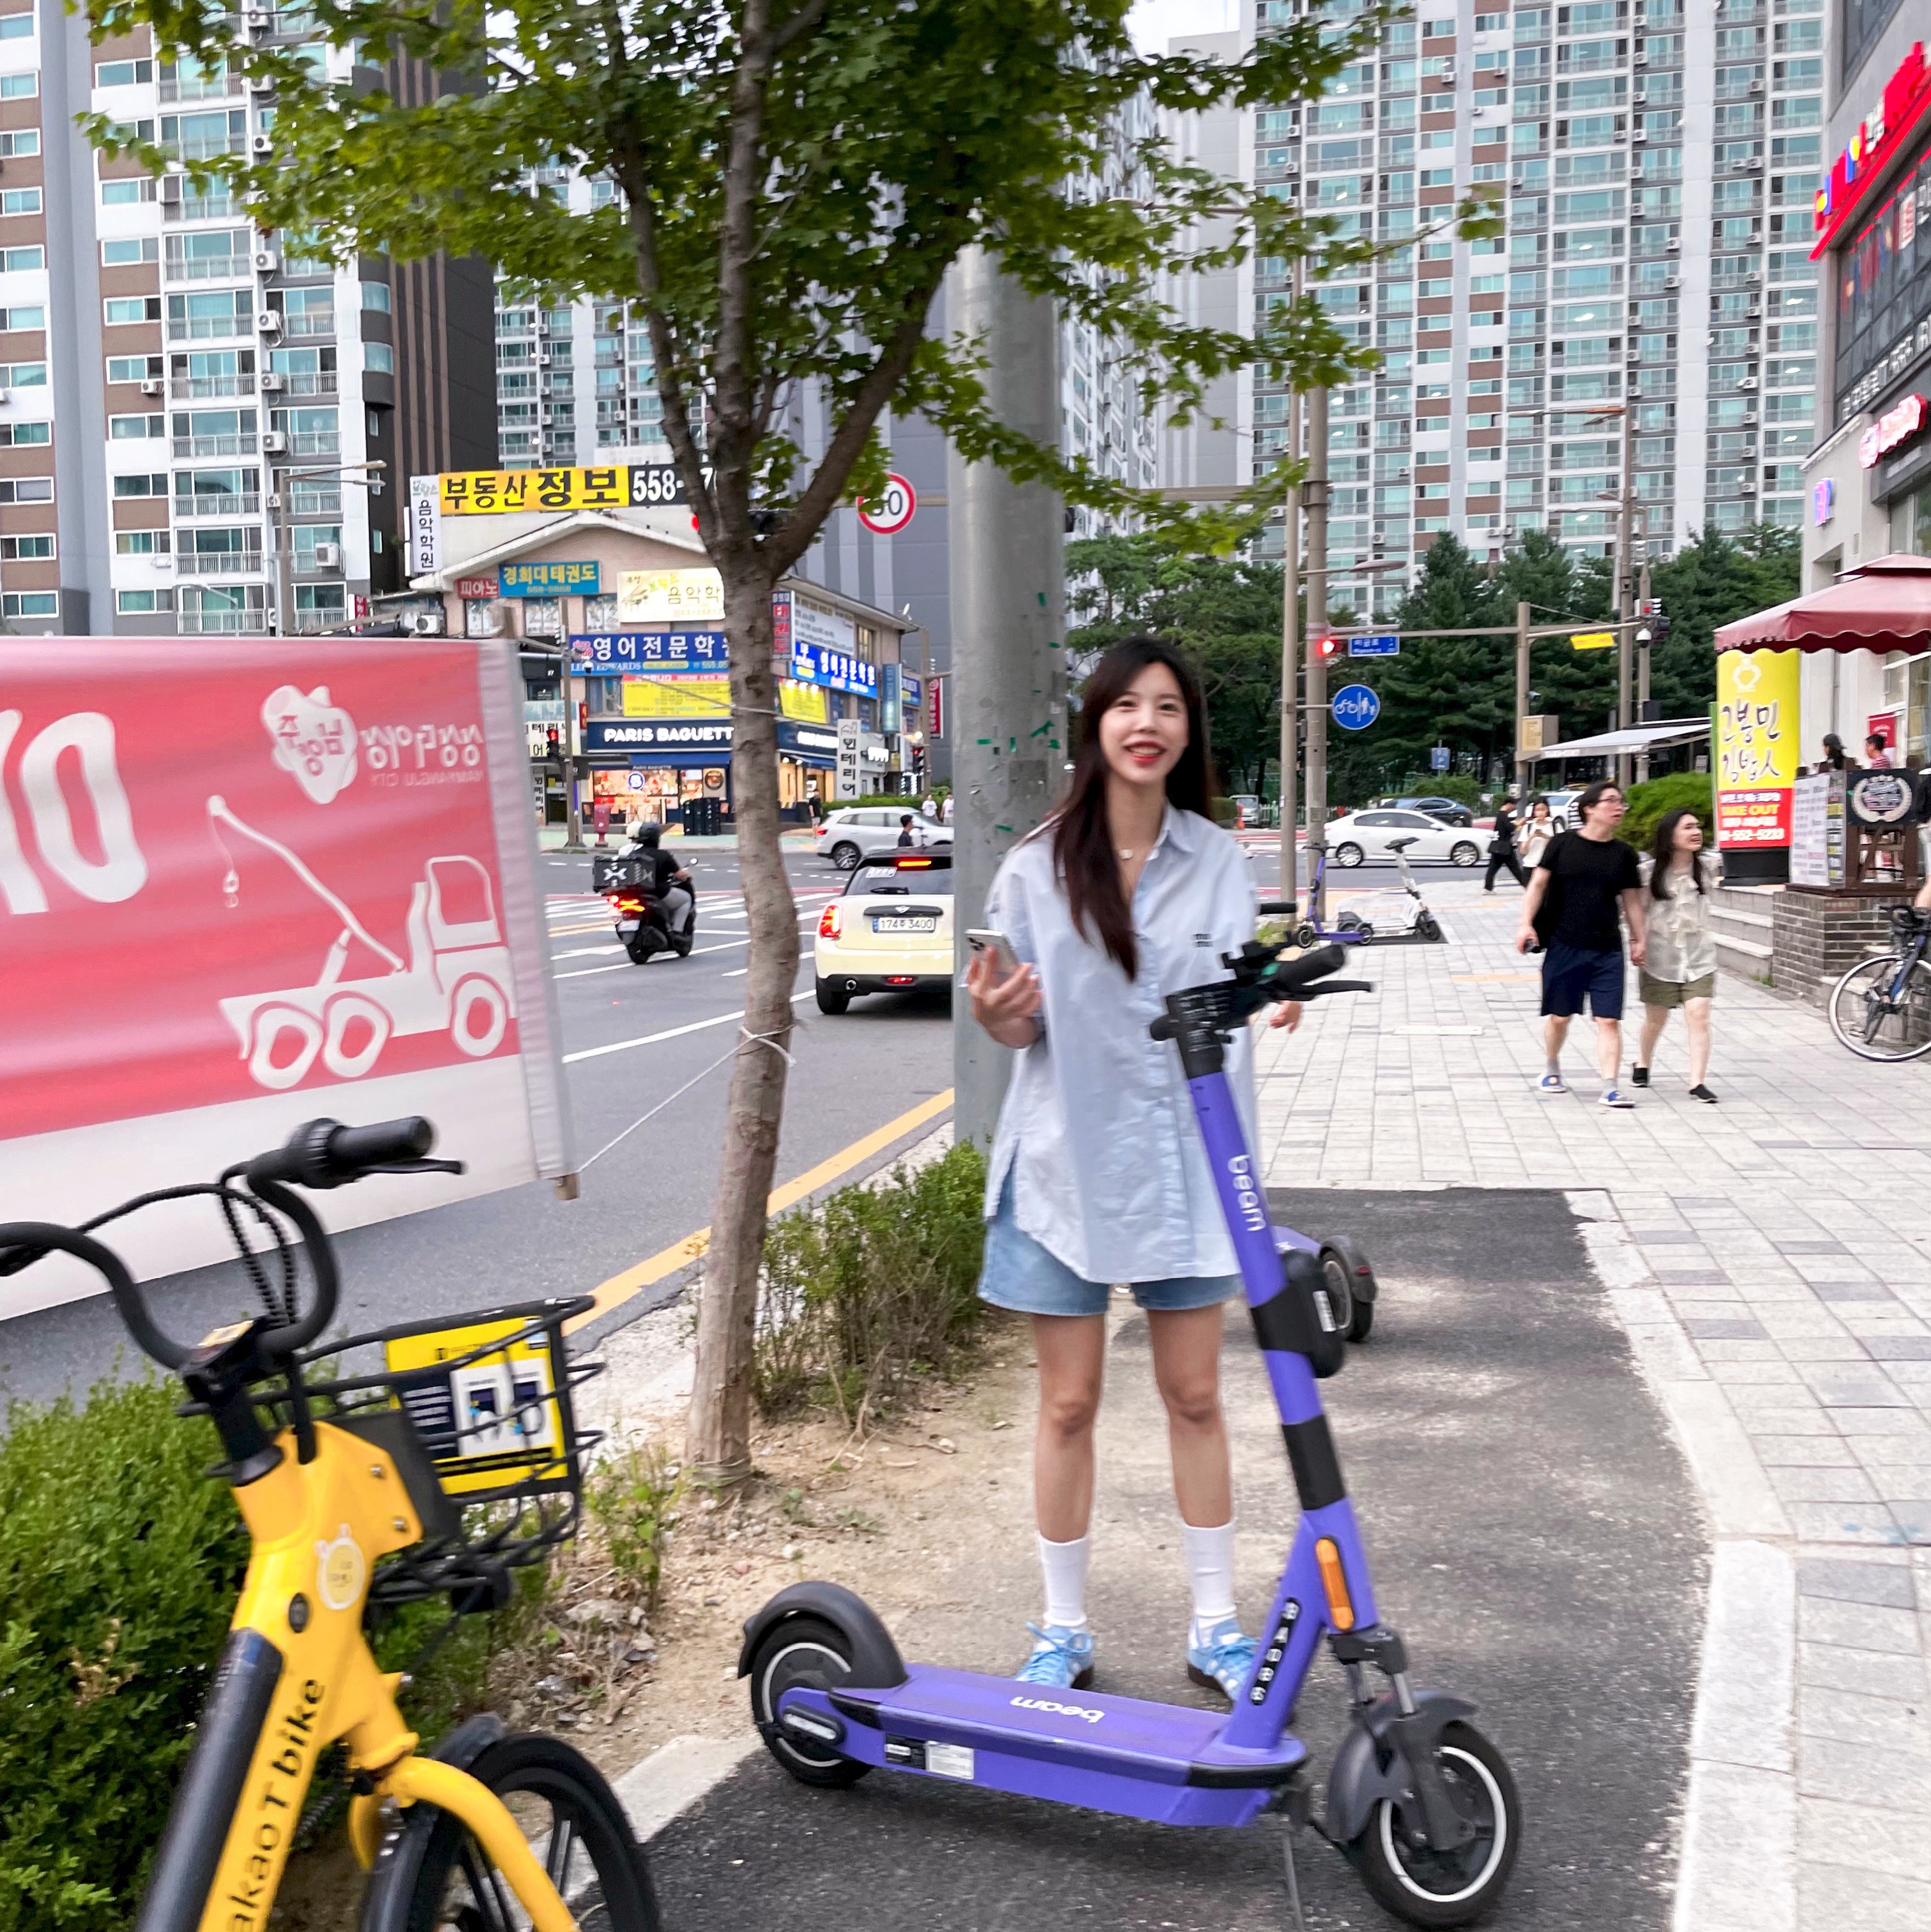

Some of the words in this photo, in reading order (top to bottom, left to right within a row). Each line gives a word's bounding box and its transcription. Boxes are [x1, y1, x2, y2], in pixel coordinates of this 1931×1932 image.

[445, 475, 527, 509] 부동산
[538, 469, 619, 508] 정보
[418, 499, 435, 568] 음악학원
[460, 580, 498, 596] 피아노
[604, 727, 653, 742] PARIS
[1720, 697, 1782, 743] 고봉민
[840, 738, 856, 796] 인테리어
[1748, 804, 1780, 815] OUT
[908, 918, 932, 929] 3400
[1227, 1154, 1267, 1233] beam
[272, 1678, 325, 1777] bike
[1009, 1696, 1105, 1723] beam
